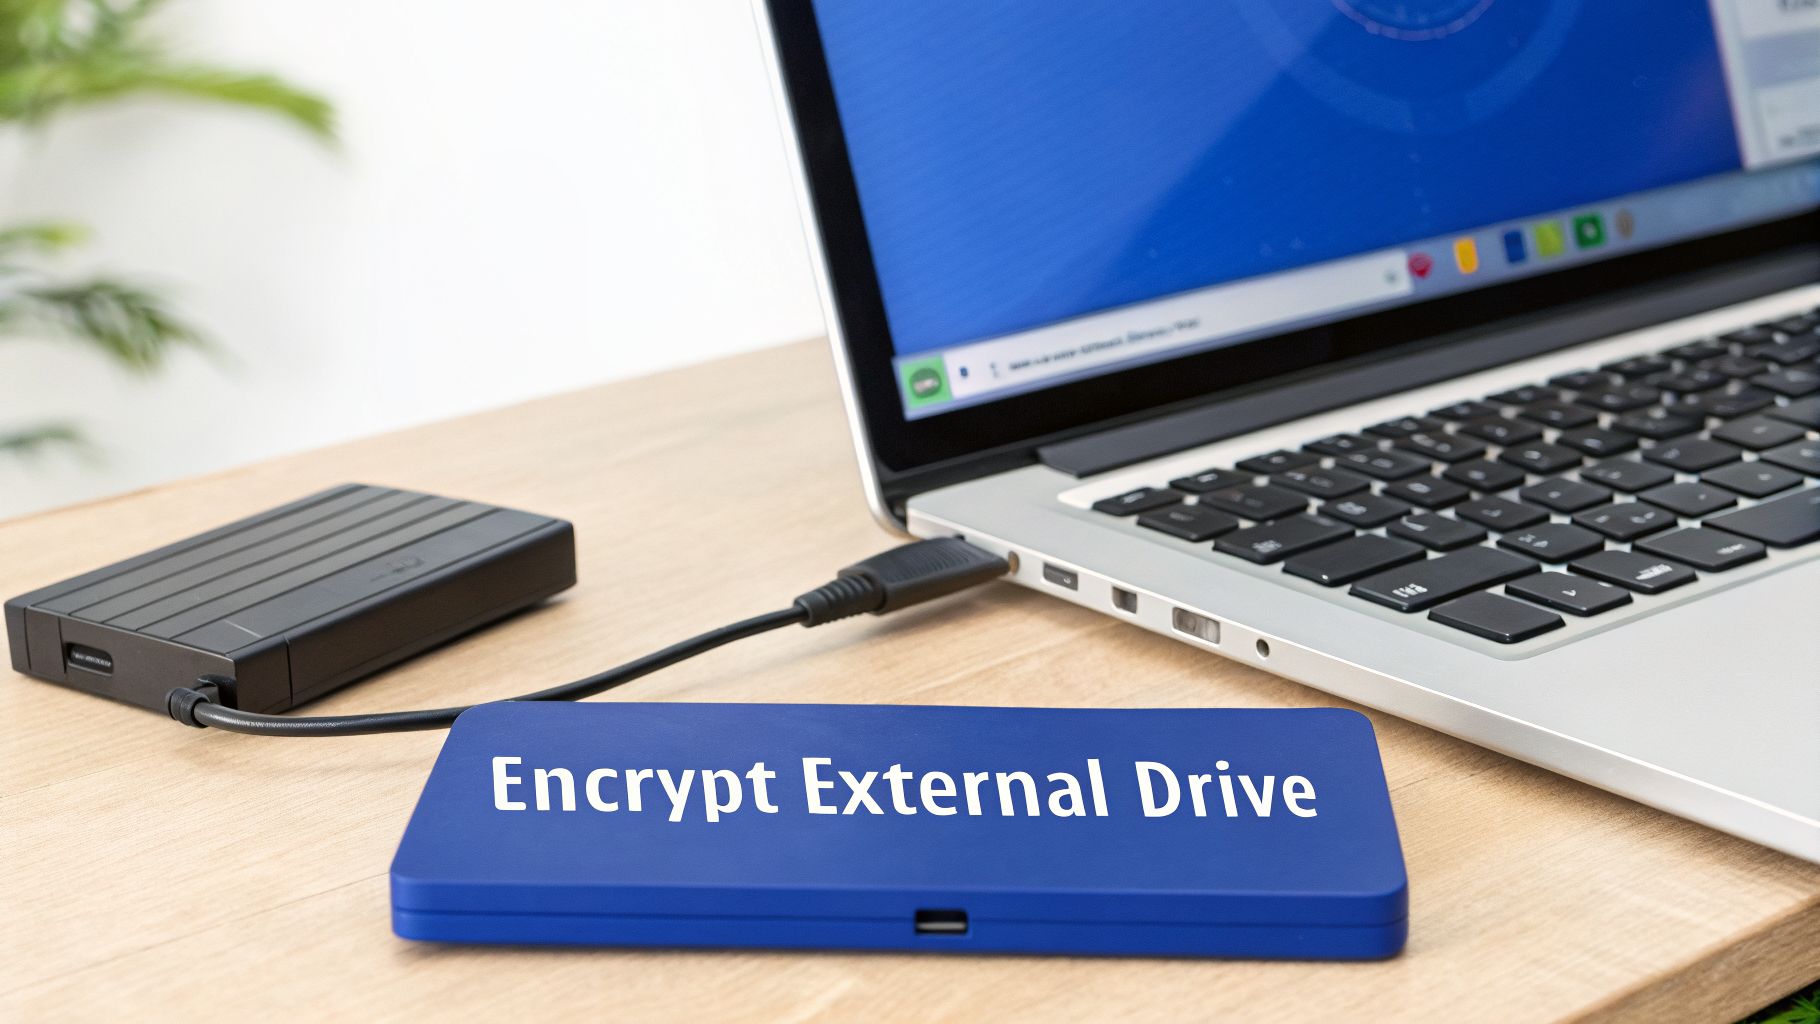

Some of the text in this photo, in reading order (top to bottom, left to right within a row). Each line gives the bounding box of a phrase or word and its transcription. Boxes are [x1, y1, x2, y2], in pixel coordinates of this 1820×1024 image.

[491, 756, 1318, 823] Encrypt External Drive
